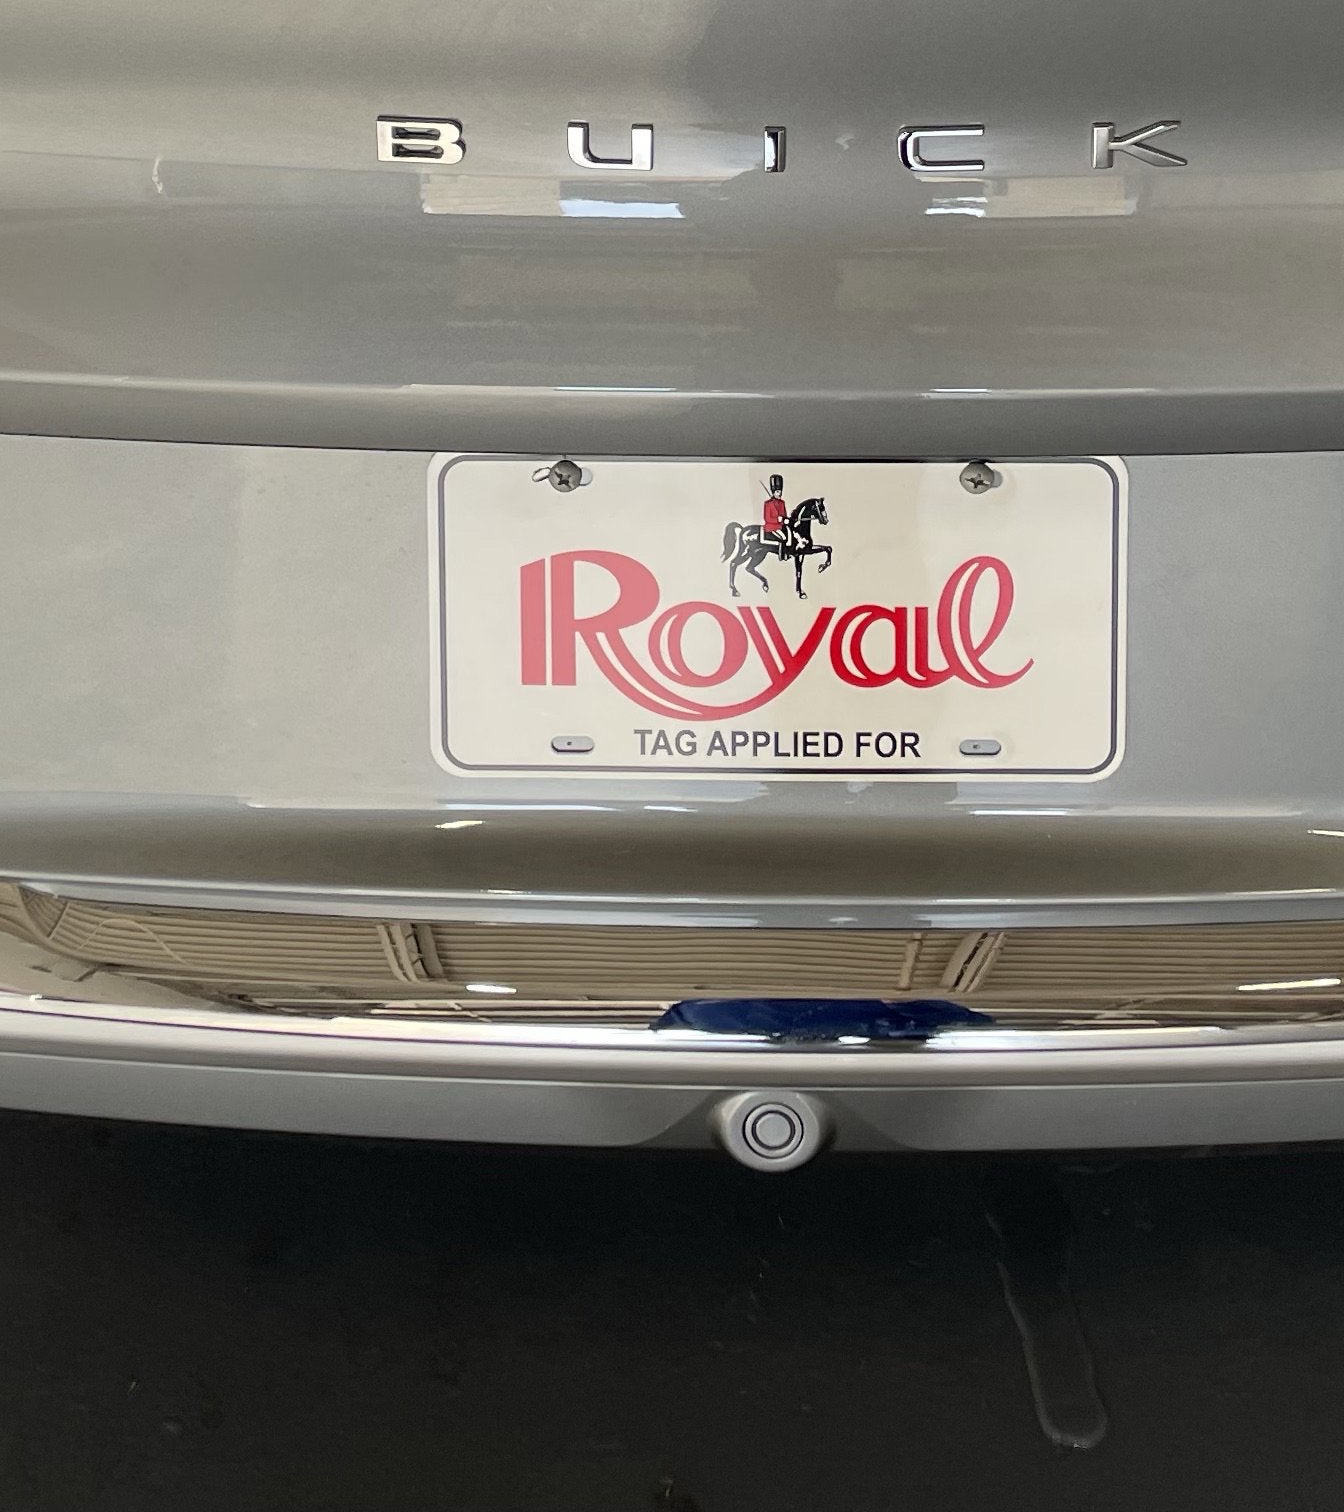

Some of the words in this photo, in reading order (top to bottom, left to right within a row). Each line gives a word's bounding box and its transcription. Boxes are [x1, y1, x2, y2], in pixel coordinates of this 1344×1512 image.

[376, 115, 1188, 172] BUICK
[520, 549, 1034, 721] Royal
[633, 729, 698, 756] TAG
[706, 730, 844, 758] APPLIED
[855, 731, 922, 758] FOR
